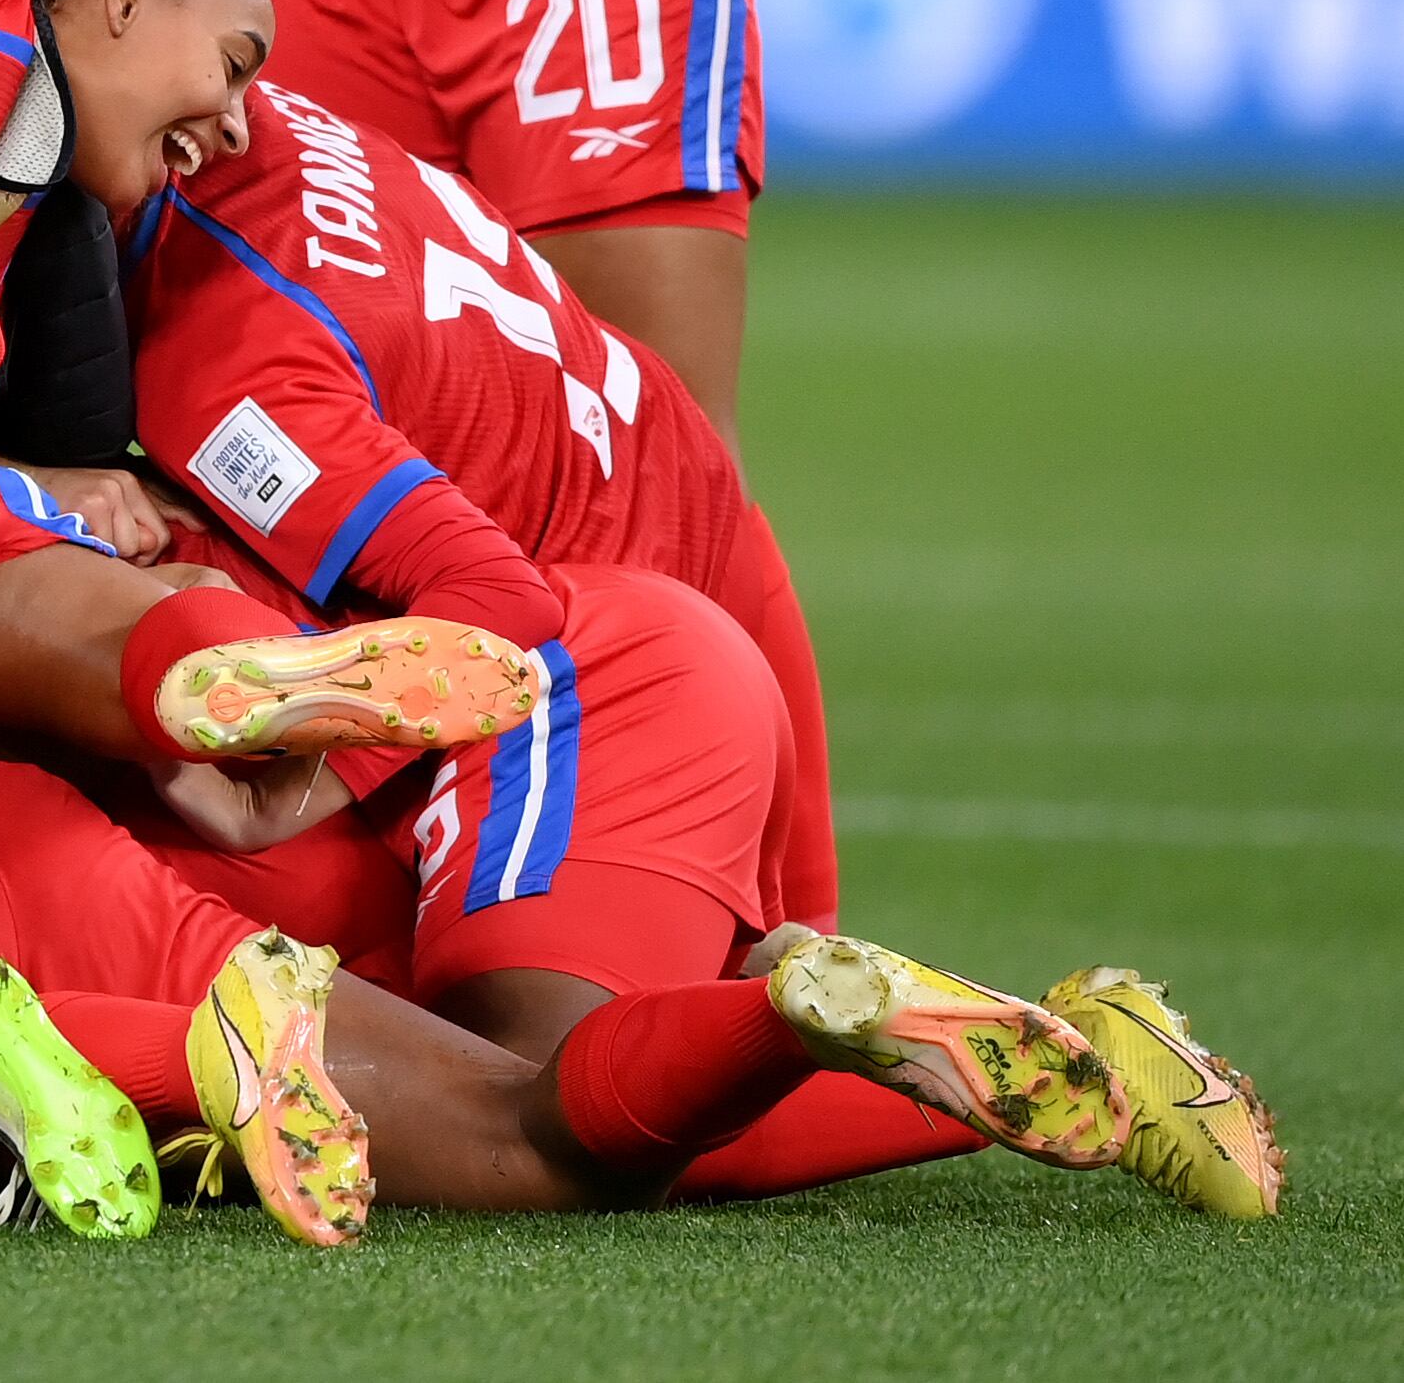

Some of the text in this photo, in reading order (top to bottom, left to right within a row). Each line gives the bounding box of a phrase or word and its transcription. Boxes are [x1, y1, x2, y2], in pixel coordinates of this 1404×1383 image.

[255, 80, 387, 278] TANNER
[212, 428, 253, 472] FOOTBALL
[222, 437, 266, 485] UNITES
[237, 448, 280, 500] the World
[966, 1032, 1011, 1093] ZOOM
